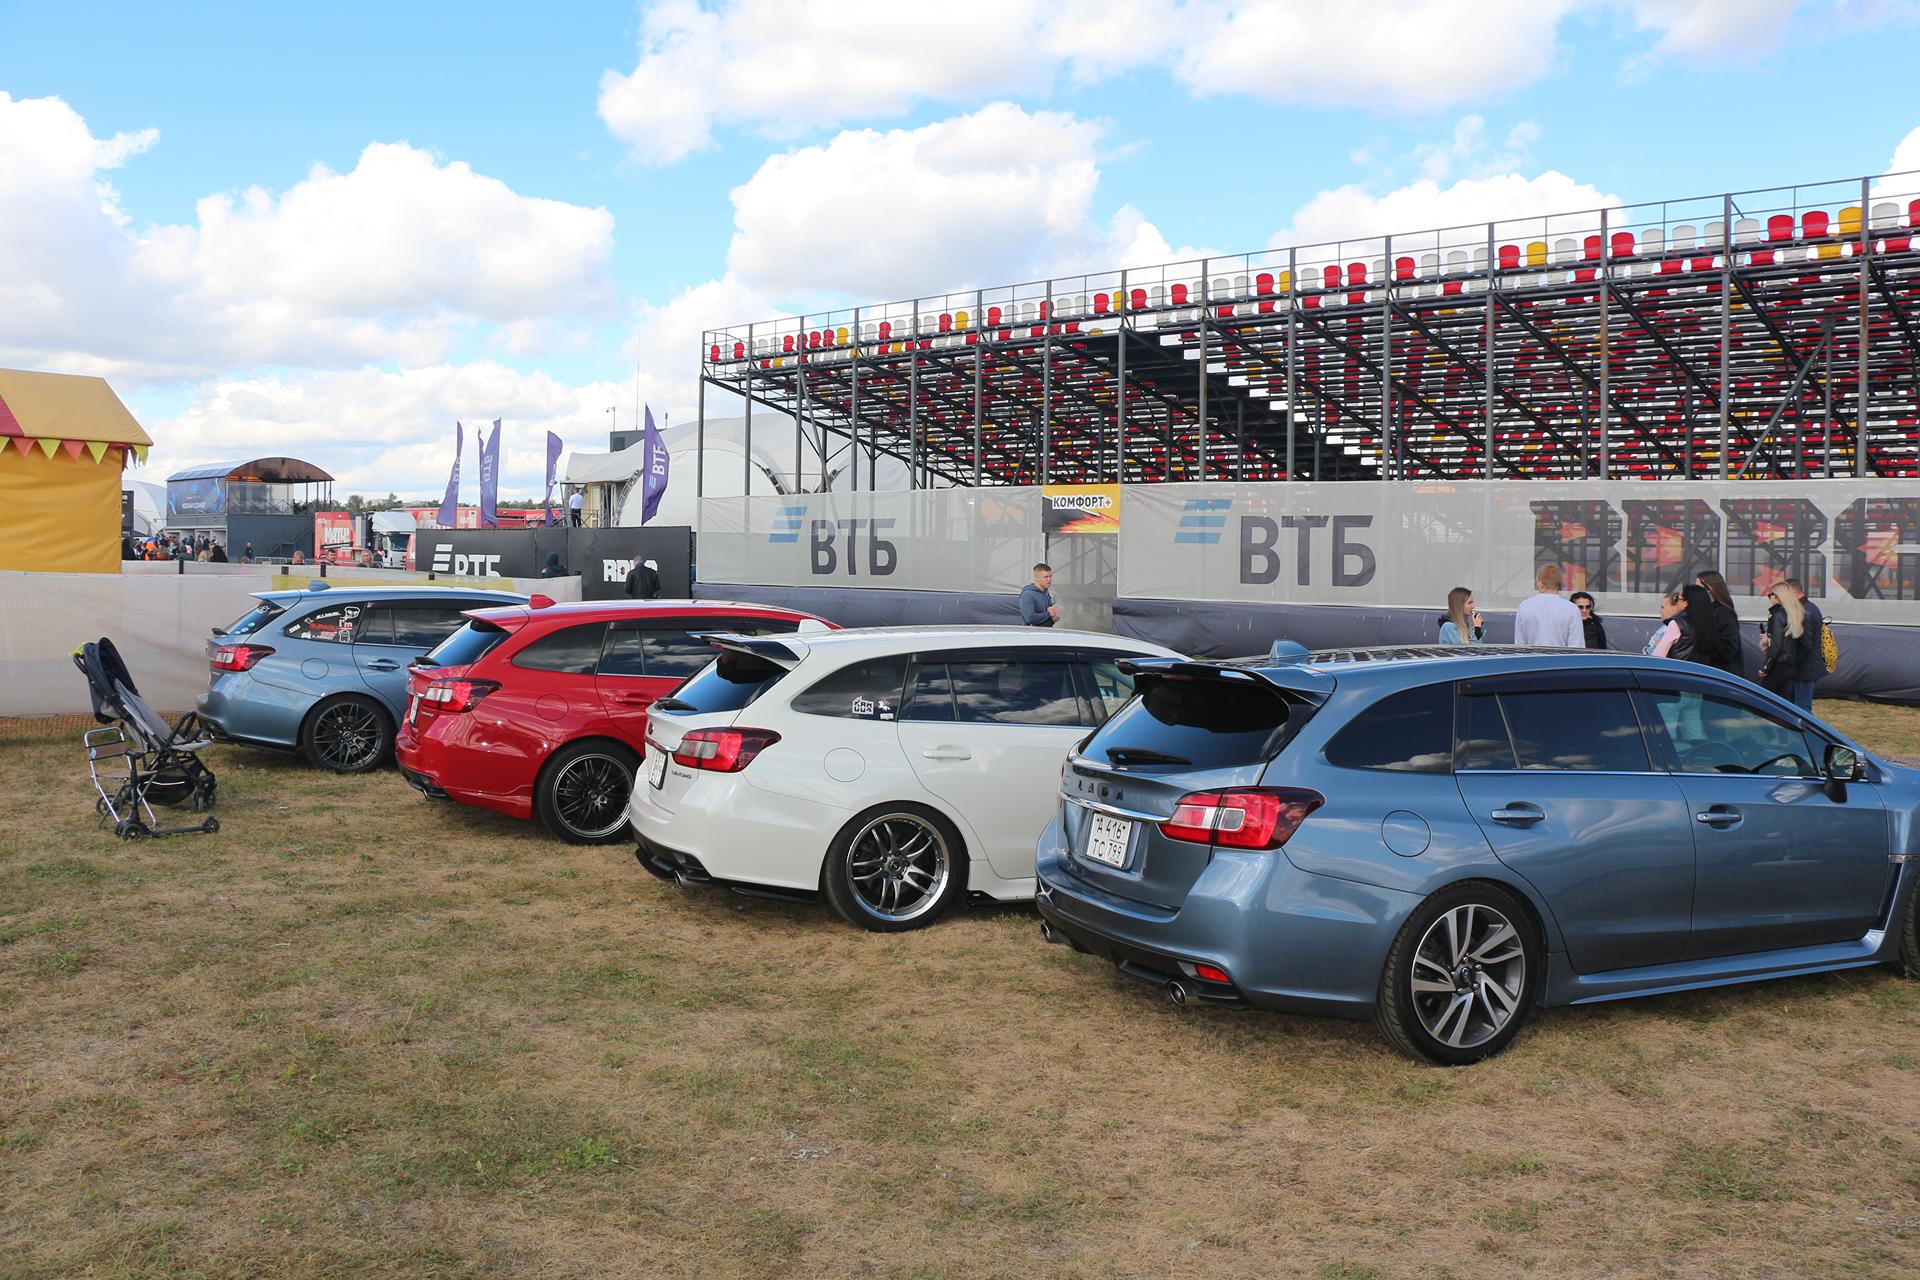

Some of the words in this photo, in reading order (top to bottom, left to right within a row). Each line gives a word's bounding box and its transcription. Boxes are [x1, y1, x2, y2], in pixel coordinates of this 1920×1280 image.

[1053, 496, 1111, 507] КОМФОРТ+
[811, 518, 897, 576] ВТБ
[1240, 515, 1376, 587] ВТБ
[1078, 780, 1123, 800] LADA
[1106, 820, 1121, 839] 416
[1107, 843, 1122, 858] 799
